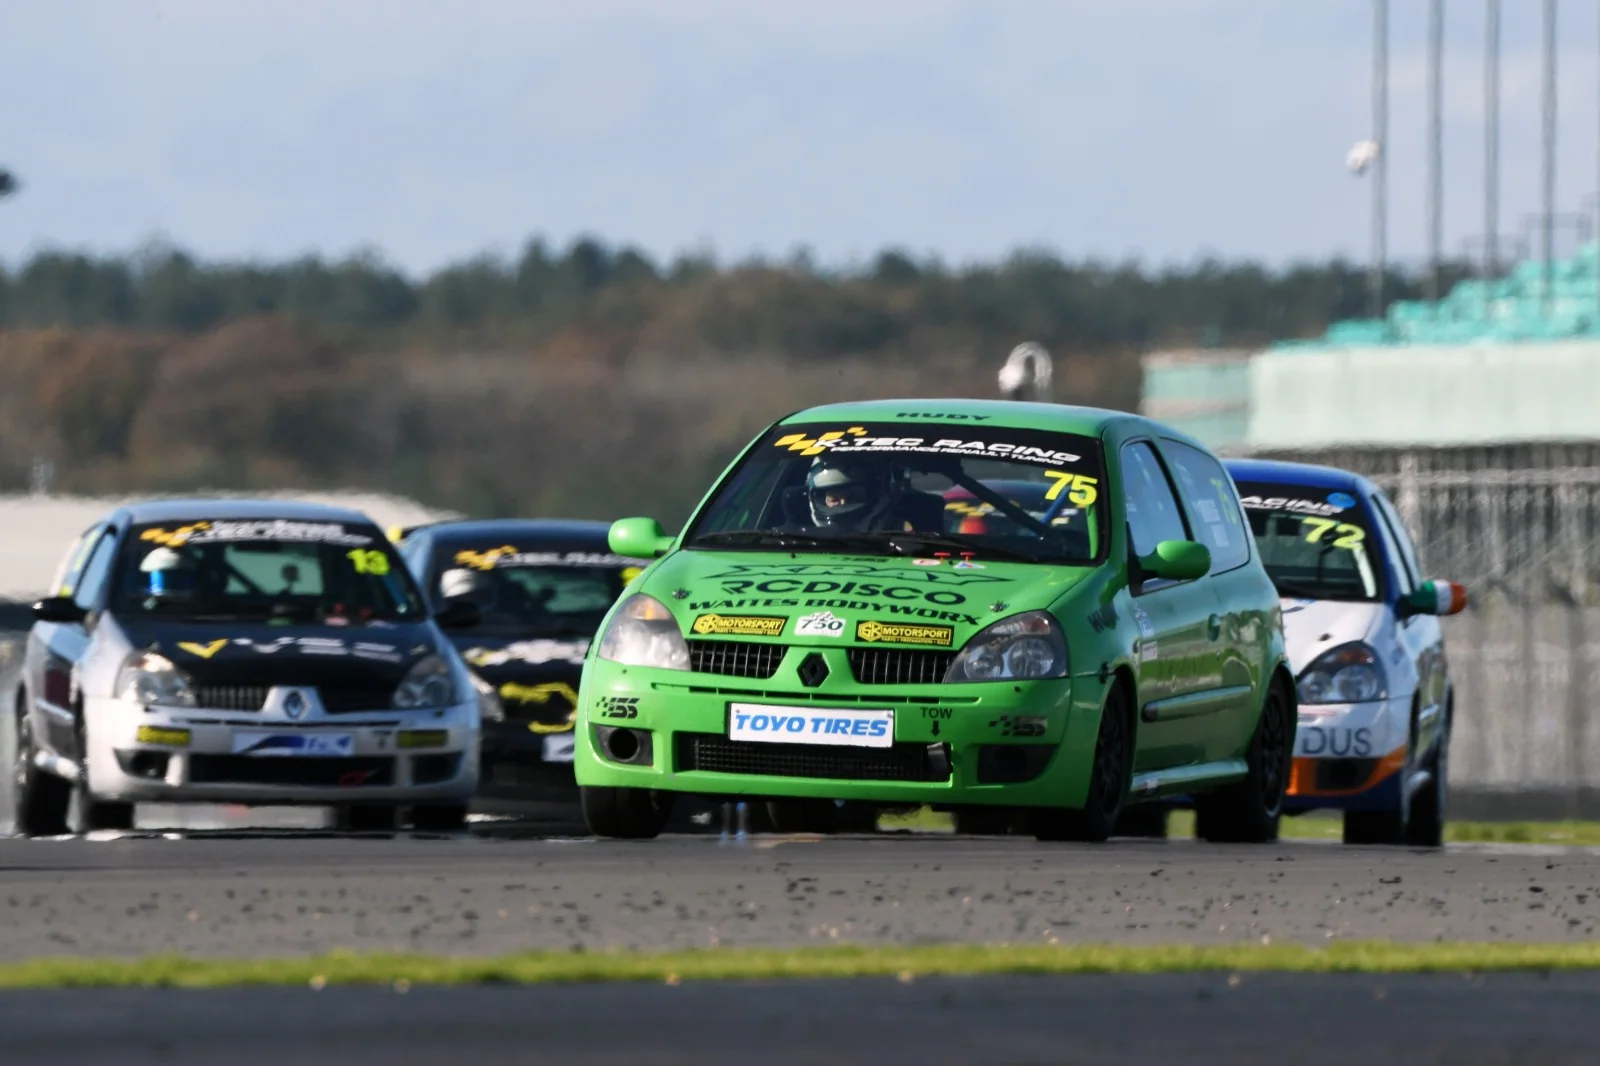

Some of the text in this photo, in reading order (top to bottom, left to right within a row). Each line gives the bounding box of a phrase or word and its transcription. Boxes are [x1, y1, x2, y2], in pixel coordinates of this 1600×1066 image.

[896, 413, 991, 421] HUDY
[830, 446, 1065, 466] PERFORMANCE RENAULT TUNING
[933, 438, 1082, 463] RACING
[1044, 470, 1099, 506] 75
[1302, 516, 1366, 550] 72
[689, 598, 983, 626] WAITES BODYWORX
[719, 618, 783, 630] MOTORSPORT
[801, 618, 844, 632] 750
[882, 627, 949, 639] MOTORSPORT
[920, 707, 953, 719] TOW
[735, 714, 889, 737] TOYO TIRES
[1301, 726, 1373, 757] DUS
